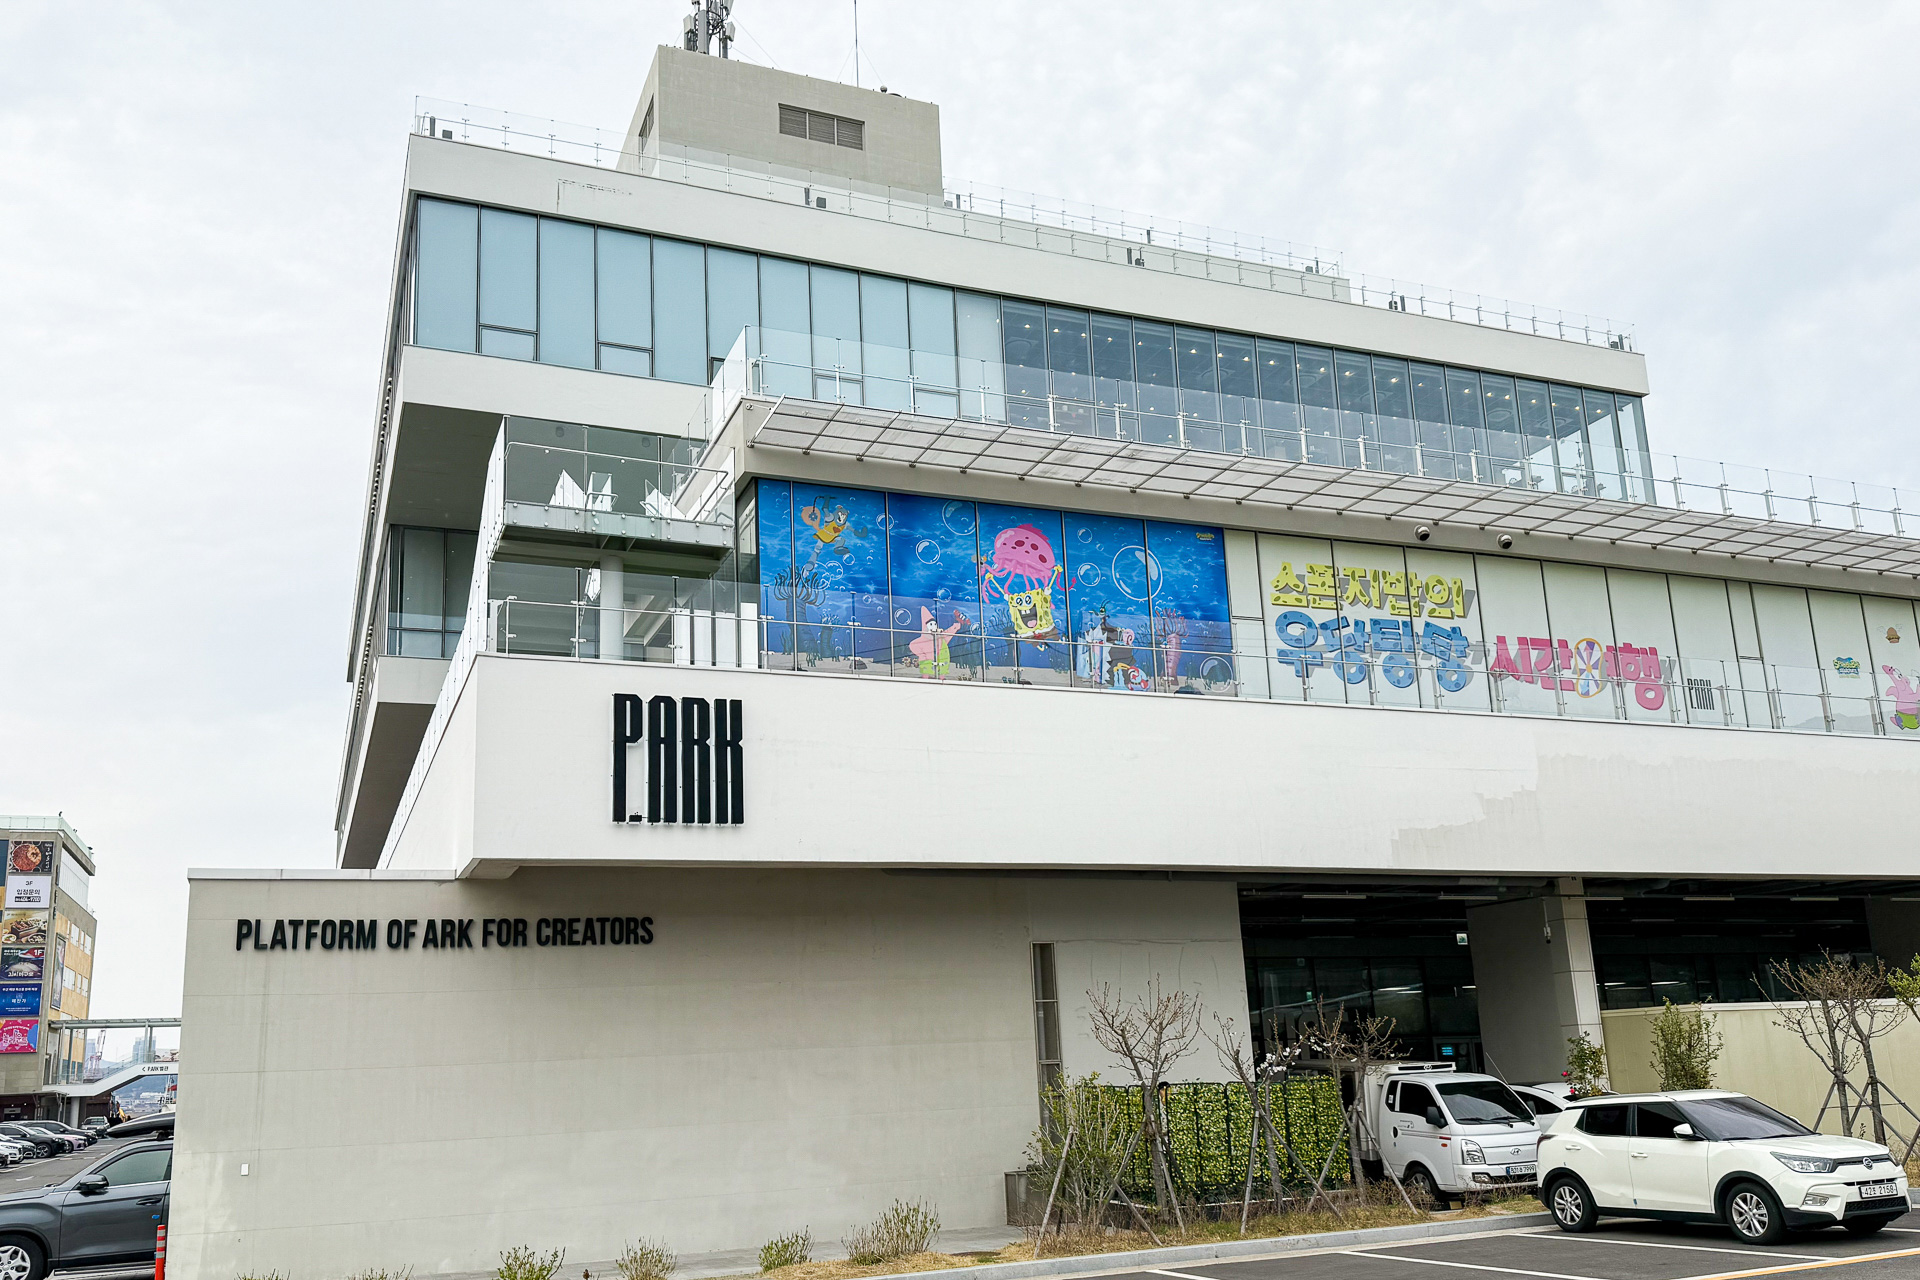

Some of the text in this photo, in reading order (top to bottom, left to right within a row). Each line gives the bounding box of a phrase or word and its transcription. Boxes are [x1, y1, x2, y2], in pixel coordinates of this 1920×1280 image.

[1270, 562, 1465, 618] 스폰지밥의
[1275, 611, 1469, 692] 우당탕탕
[236, 916, 654, 951] PLATFORM OF ARK FOR CREATORS
